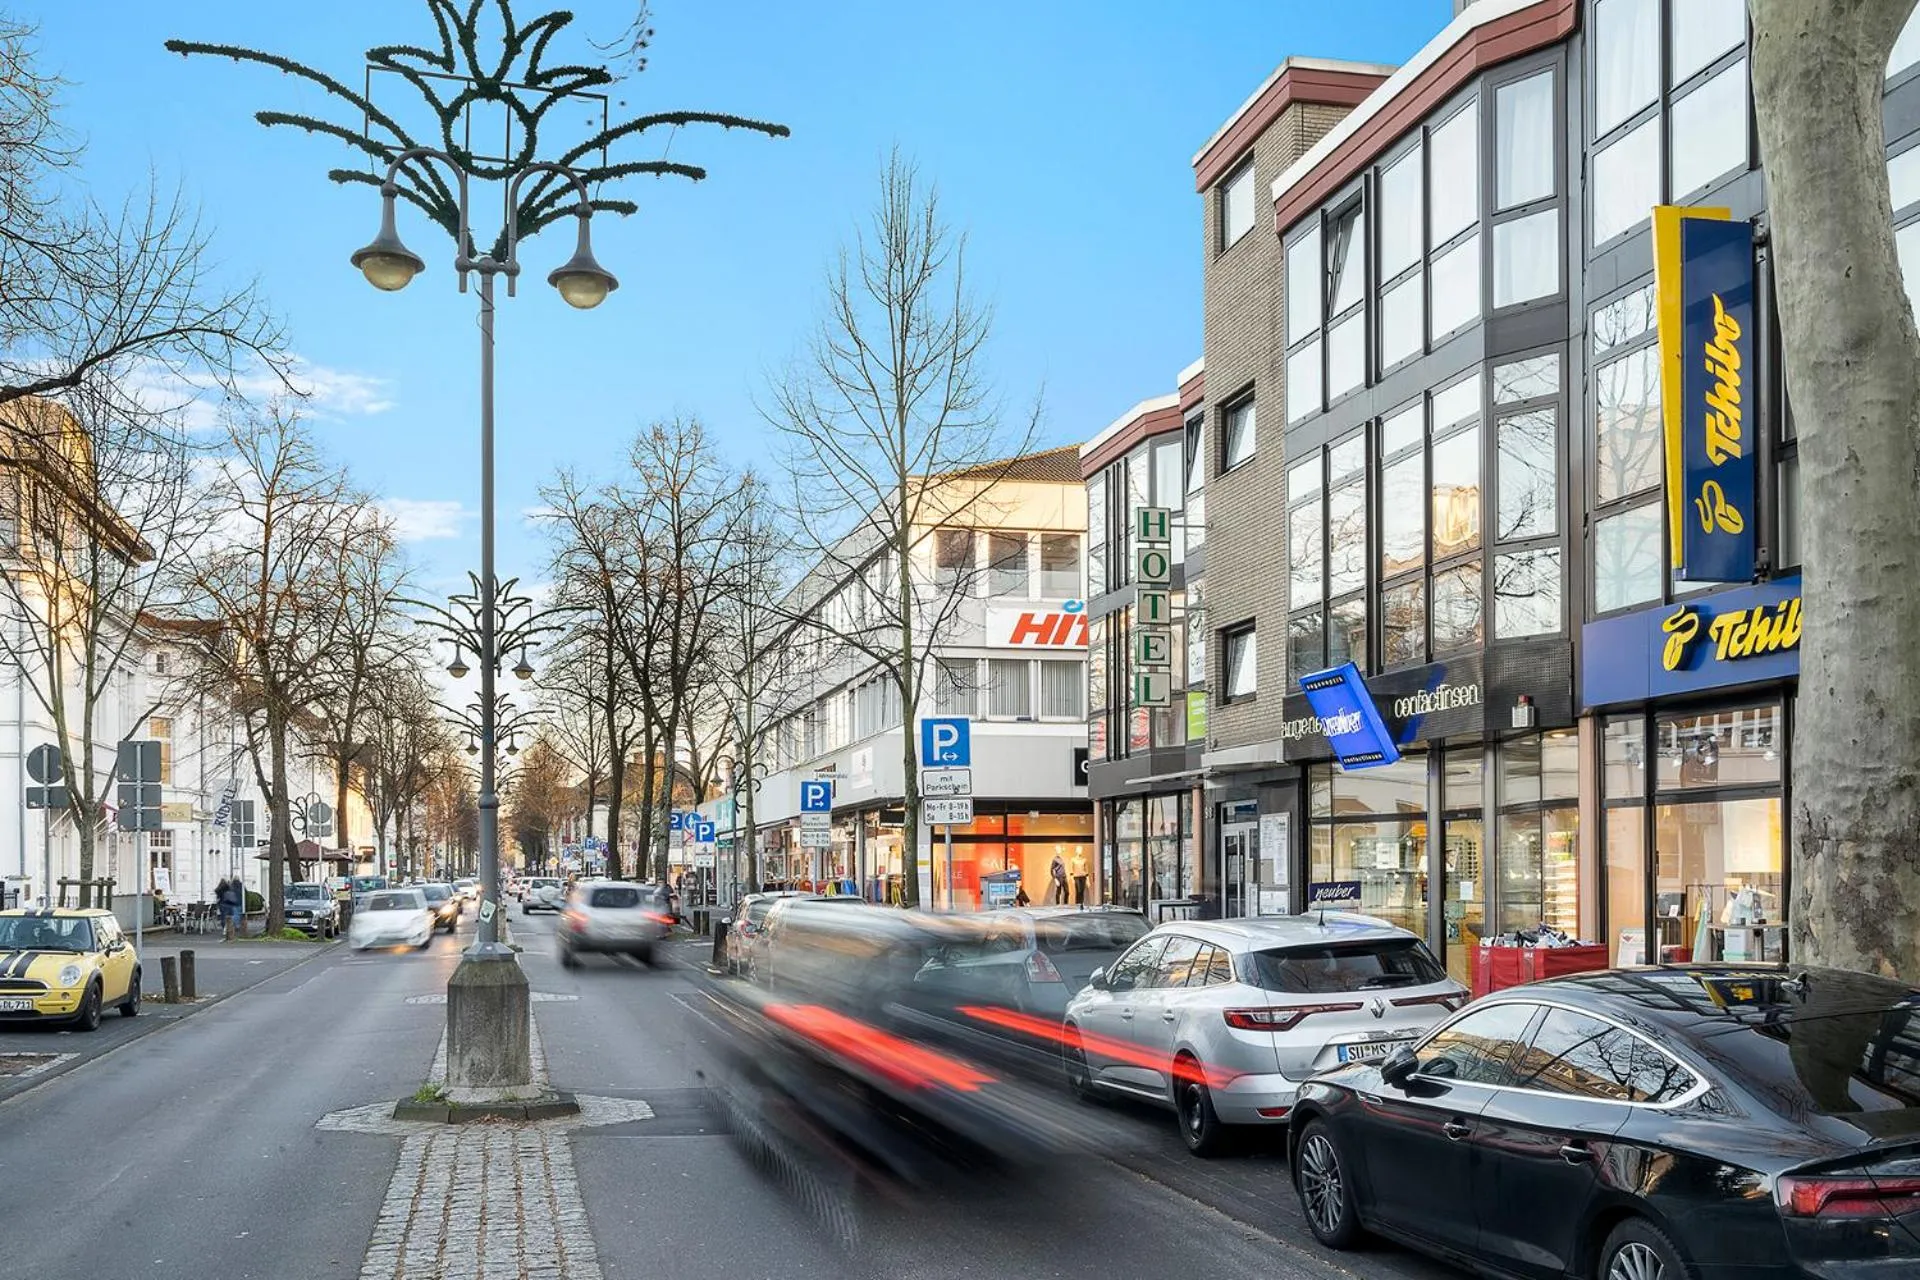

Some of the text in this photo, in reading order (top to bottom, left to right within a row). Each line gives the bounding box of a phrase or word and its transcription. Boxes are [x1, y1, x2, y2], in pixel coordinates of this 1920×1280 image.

[1705, 293, 1741, 466] Tchibo
[1142, 511, 1167, 703] HOTEL
[1708, 597, 1802, 661] Tchib
[1394, 684, 1483, 718] contactlinsen
[933, 724, 959, 761] P
[807, 785, 824, 808] P
[700, 825, 710, 841] P
[1315, 884, 1355, 899] neuber
